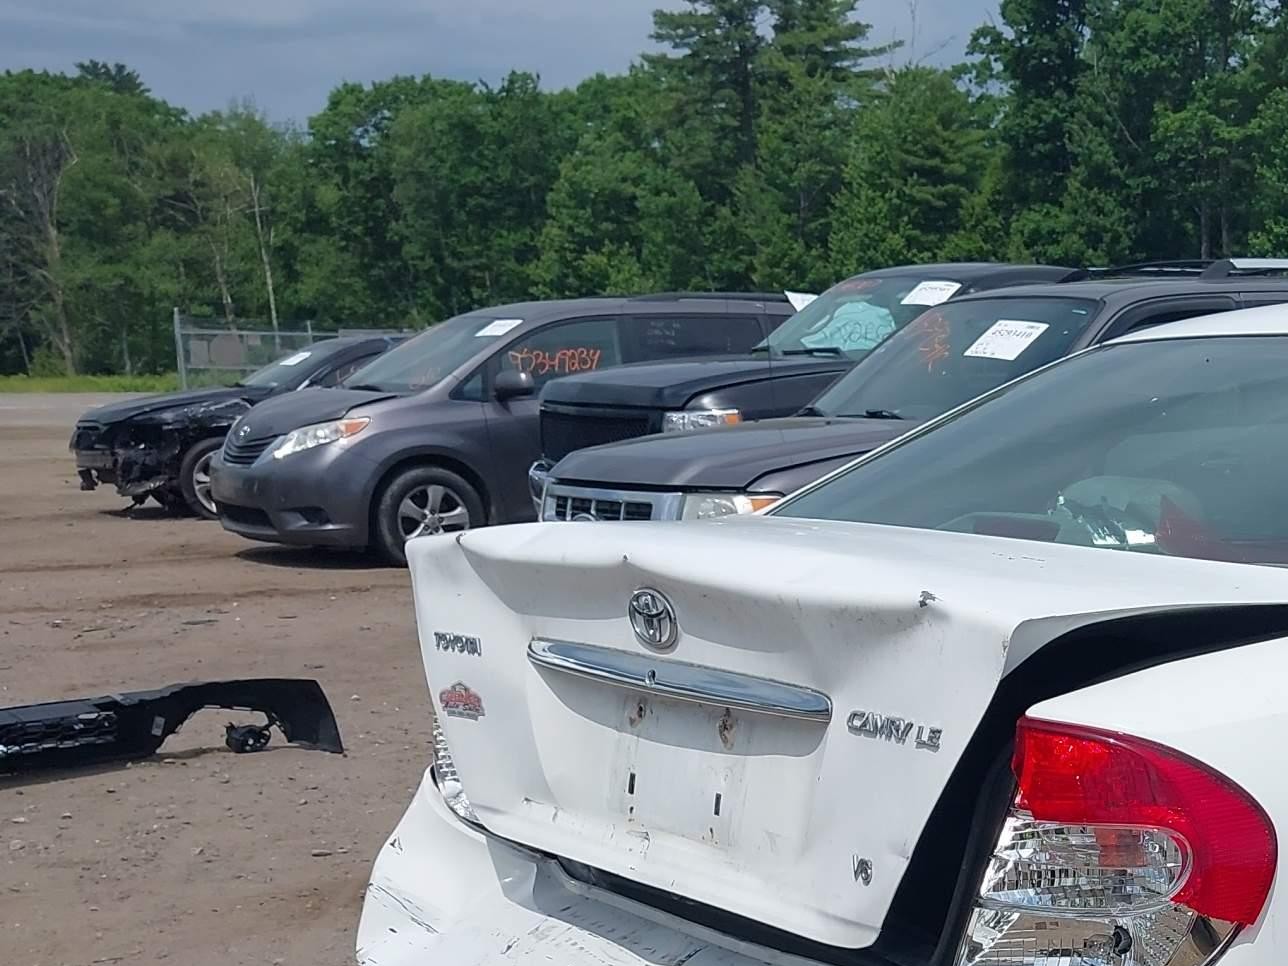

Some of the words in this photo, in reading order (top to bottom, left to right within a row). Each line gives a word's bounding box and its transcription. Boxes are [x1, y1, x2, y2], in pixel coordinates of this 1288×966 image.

[433, 631, 482, 656] TOYOTA
[847, 711, 914, 745] CAMRY
[914, 725, 943, 753] LE
[852, 853, 873, 887] V6
